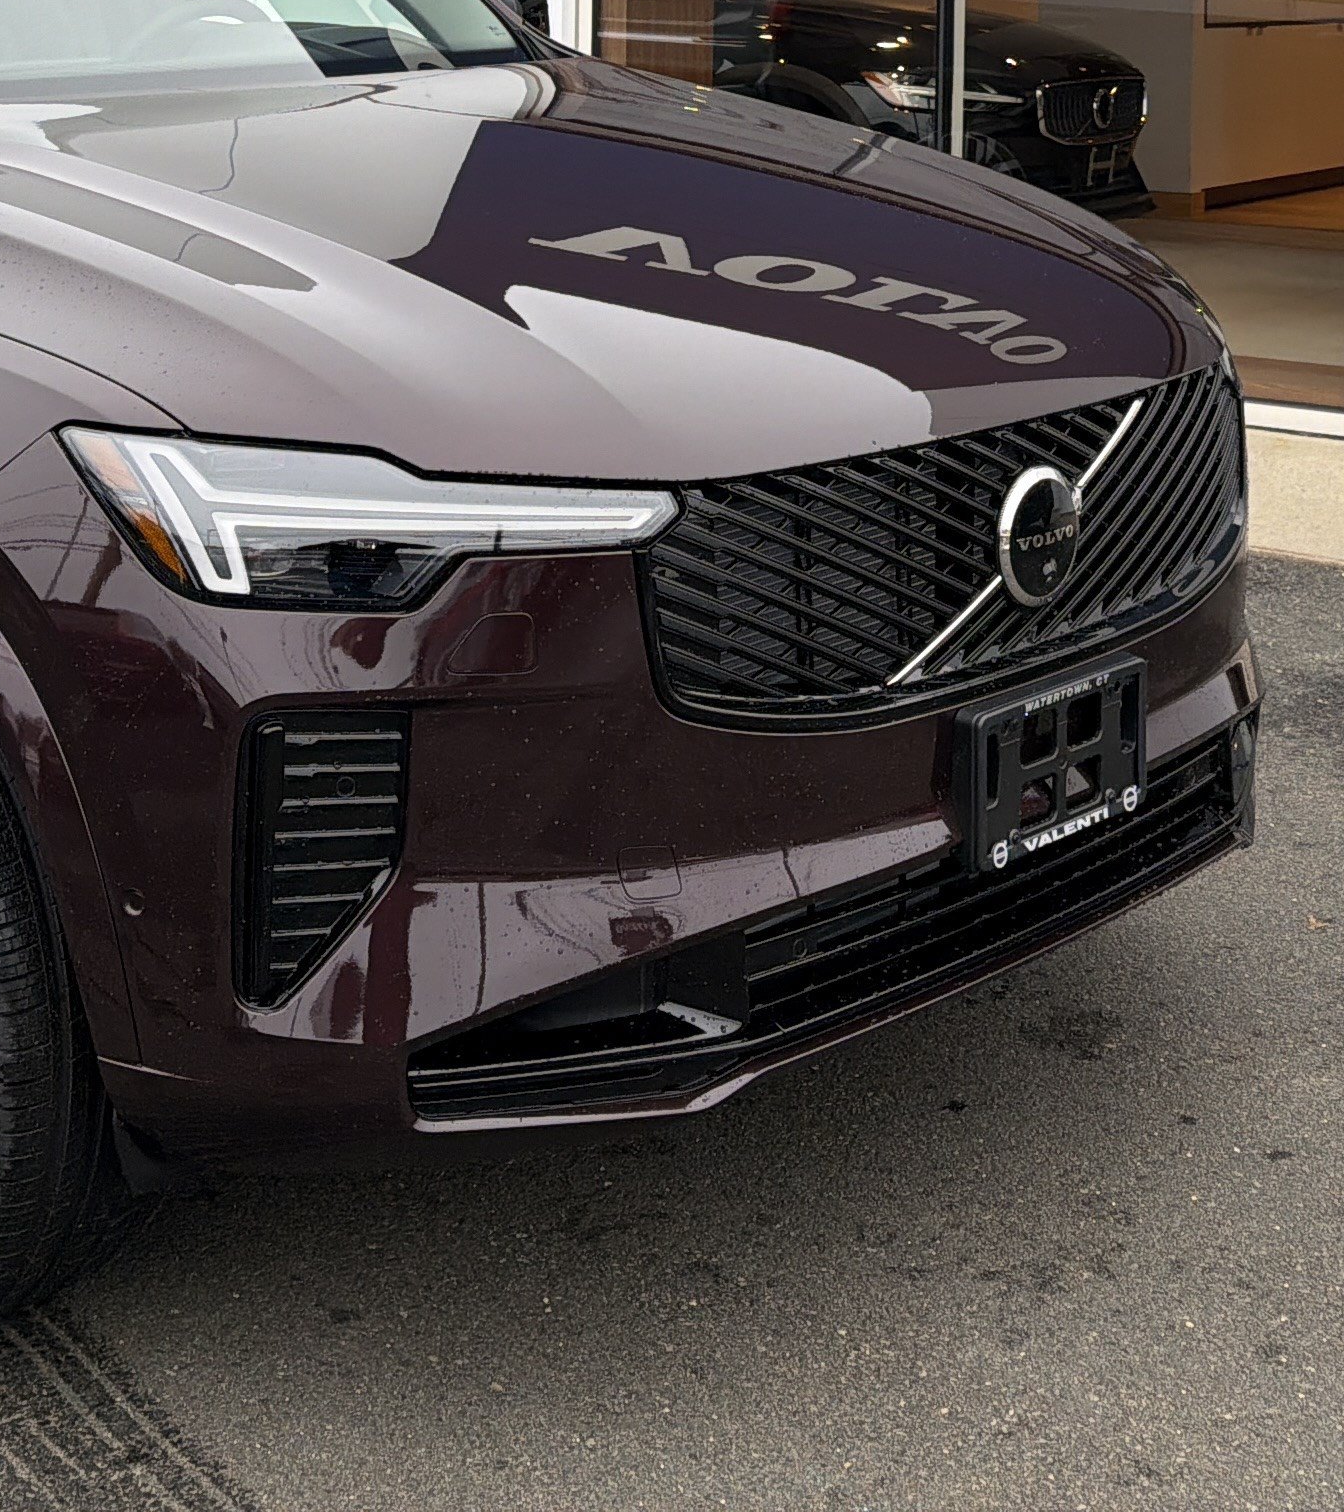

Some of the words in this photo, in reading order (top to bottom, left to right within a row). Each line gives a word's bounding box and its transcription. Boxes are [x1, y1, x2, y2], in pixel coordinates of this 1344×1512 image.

[1016, 524, 1074, 551] VOLVO
[1024, 680, 1093, 713] WATERTOWN,
[1095, 673, 1110, 688] CT
[1022, 806, 1110, 852] VALENTI
